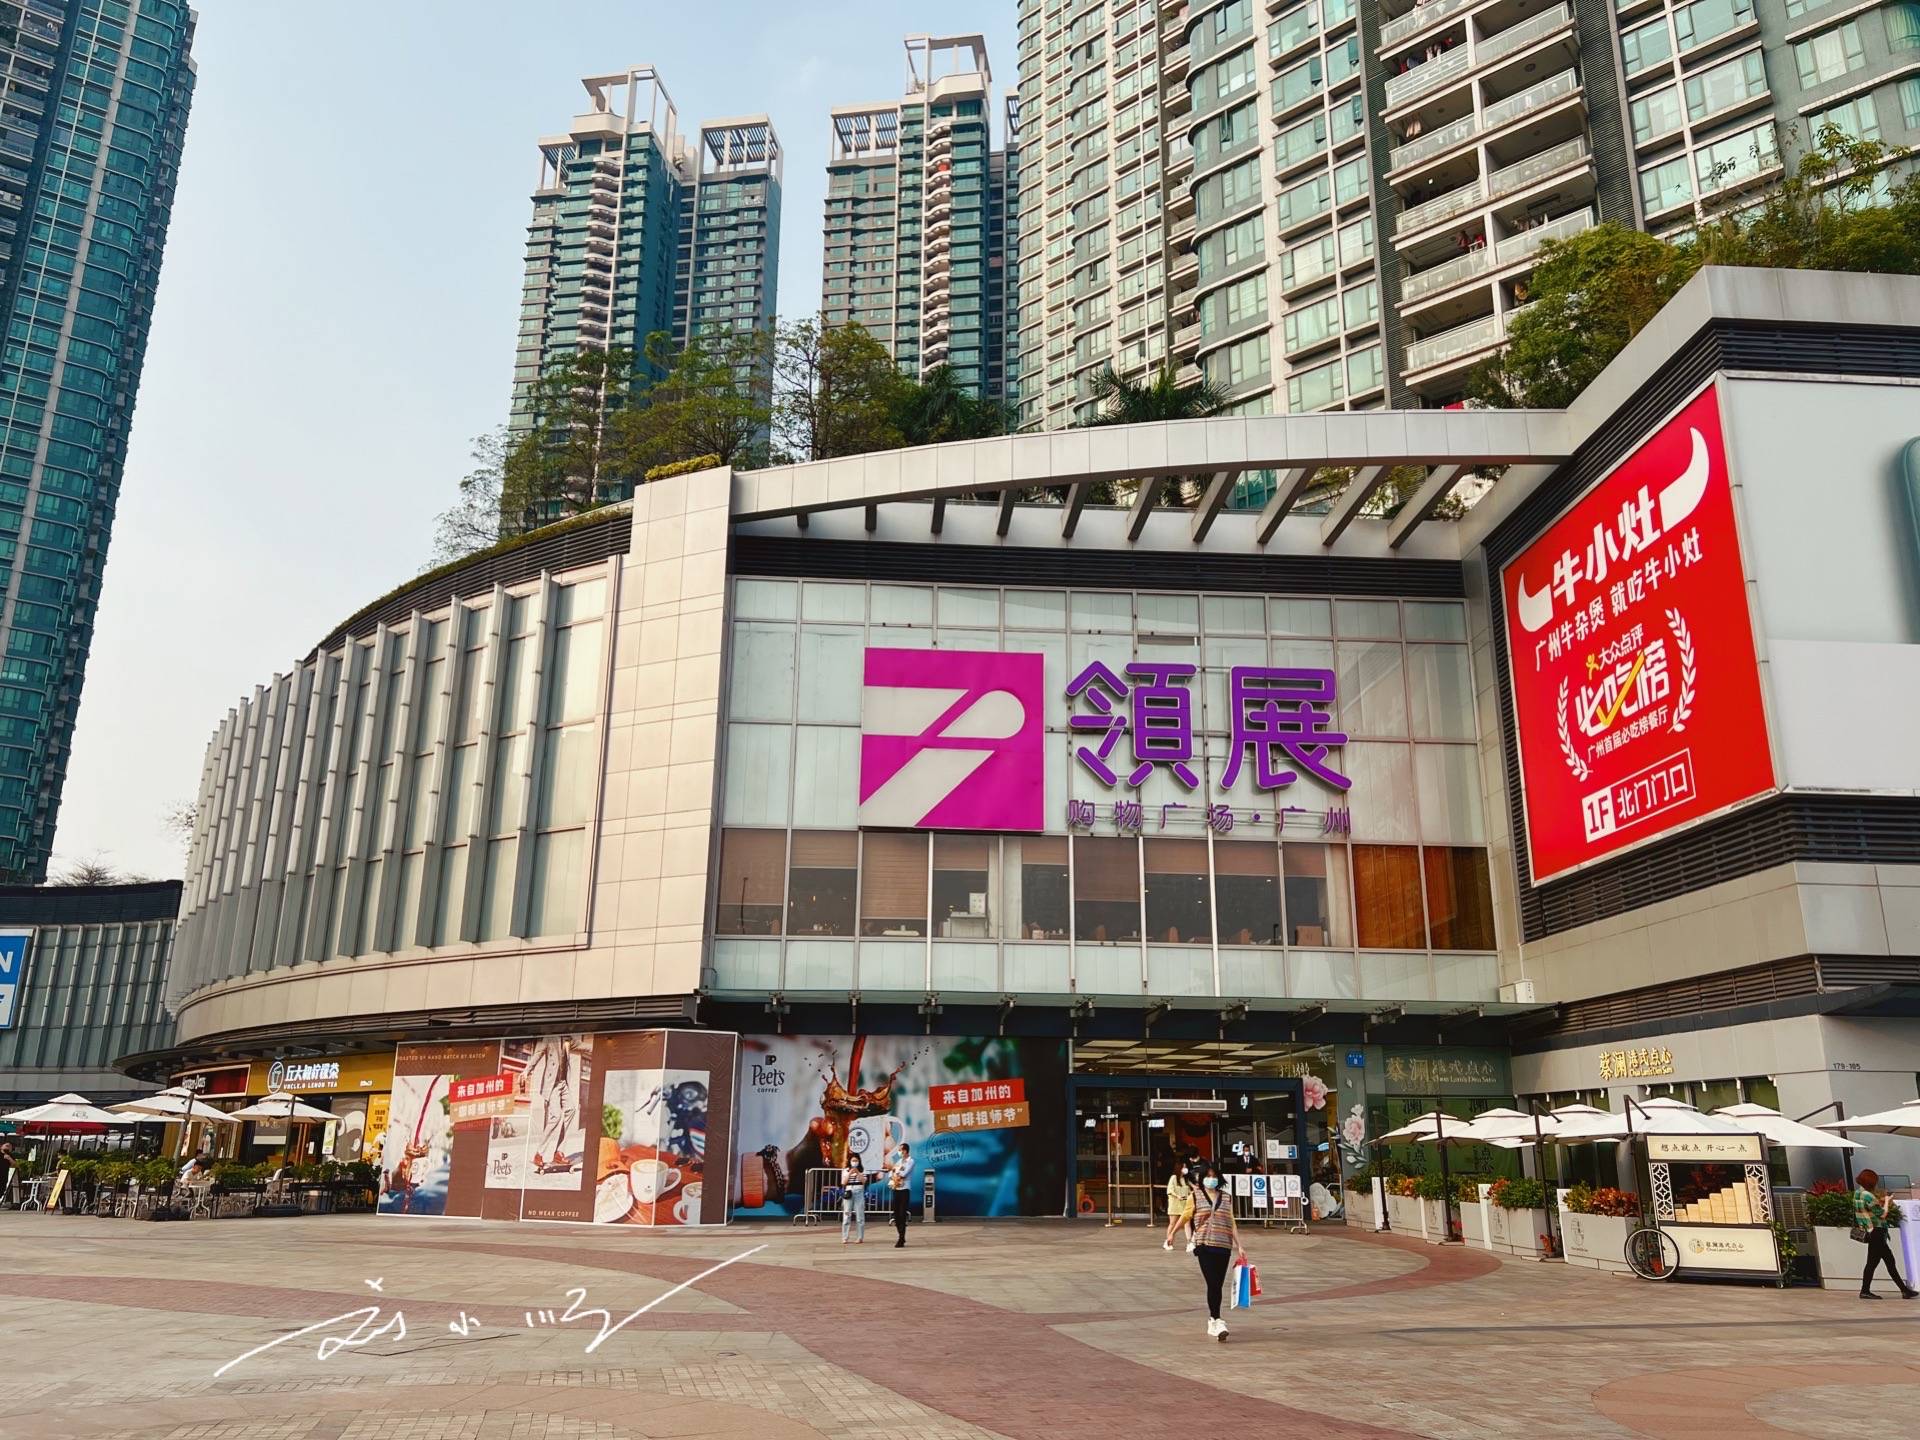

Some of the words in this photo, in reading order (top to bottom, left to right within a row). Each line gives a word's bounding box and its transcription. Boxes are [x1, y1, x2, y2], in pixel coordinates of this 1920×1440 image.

[1553, 484, 1661, 606] 牛小灶
[1536, 595, 1605, 672] 广州牛杂煲
[1610, 527, 1703, 617] 就吃牛小灶
[1598, 623, 1643, 670] 大众点评
[1575, 638, 1669, 737] 必吃榜
[1065, 660, 1352, 790] 領展
[1588, 705, 1669, 763] 广州首届必吃榜餐厅
[1587, 794, 1610, 834] 1F
[1617, 762, 1689, 820] 北门门口
[457, 1079, 504, 1098] 来自加州的
[943, 1084, 1011, 1105] 来自加州的
